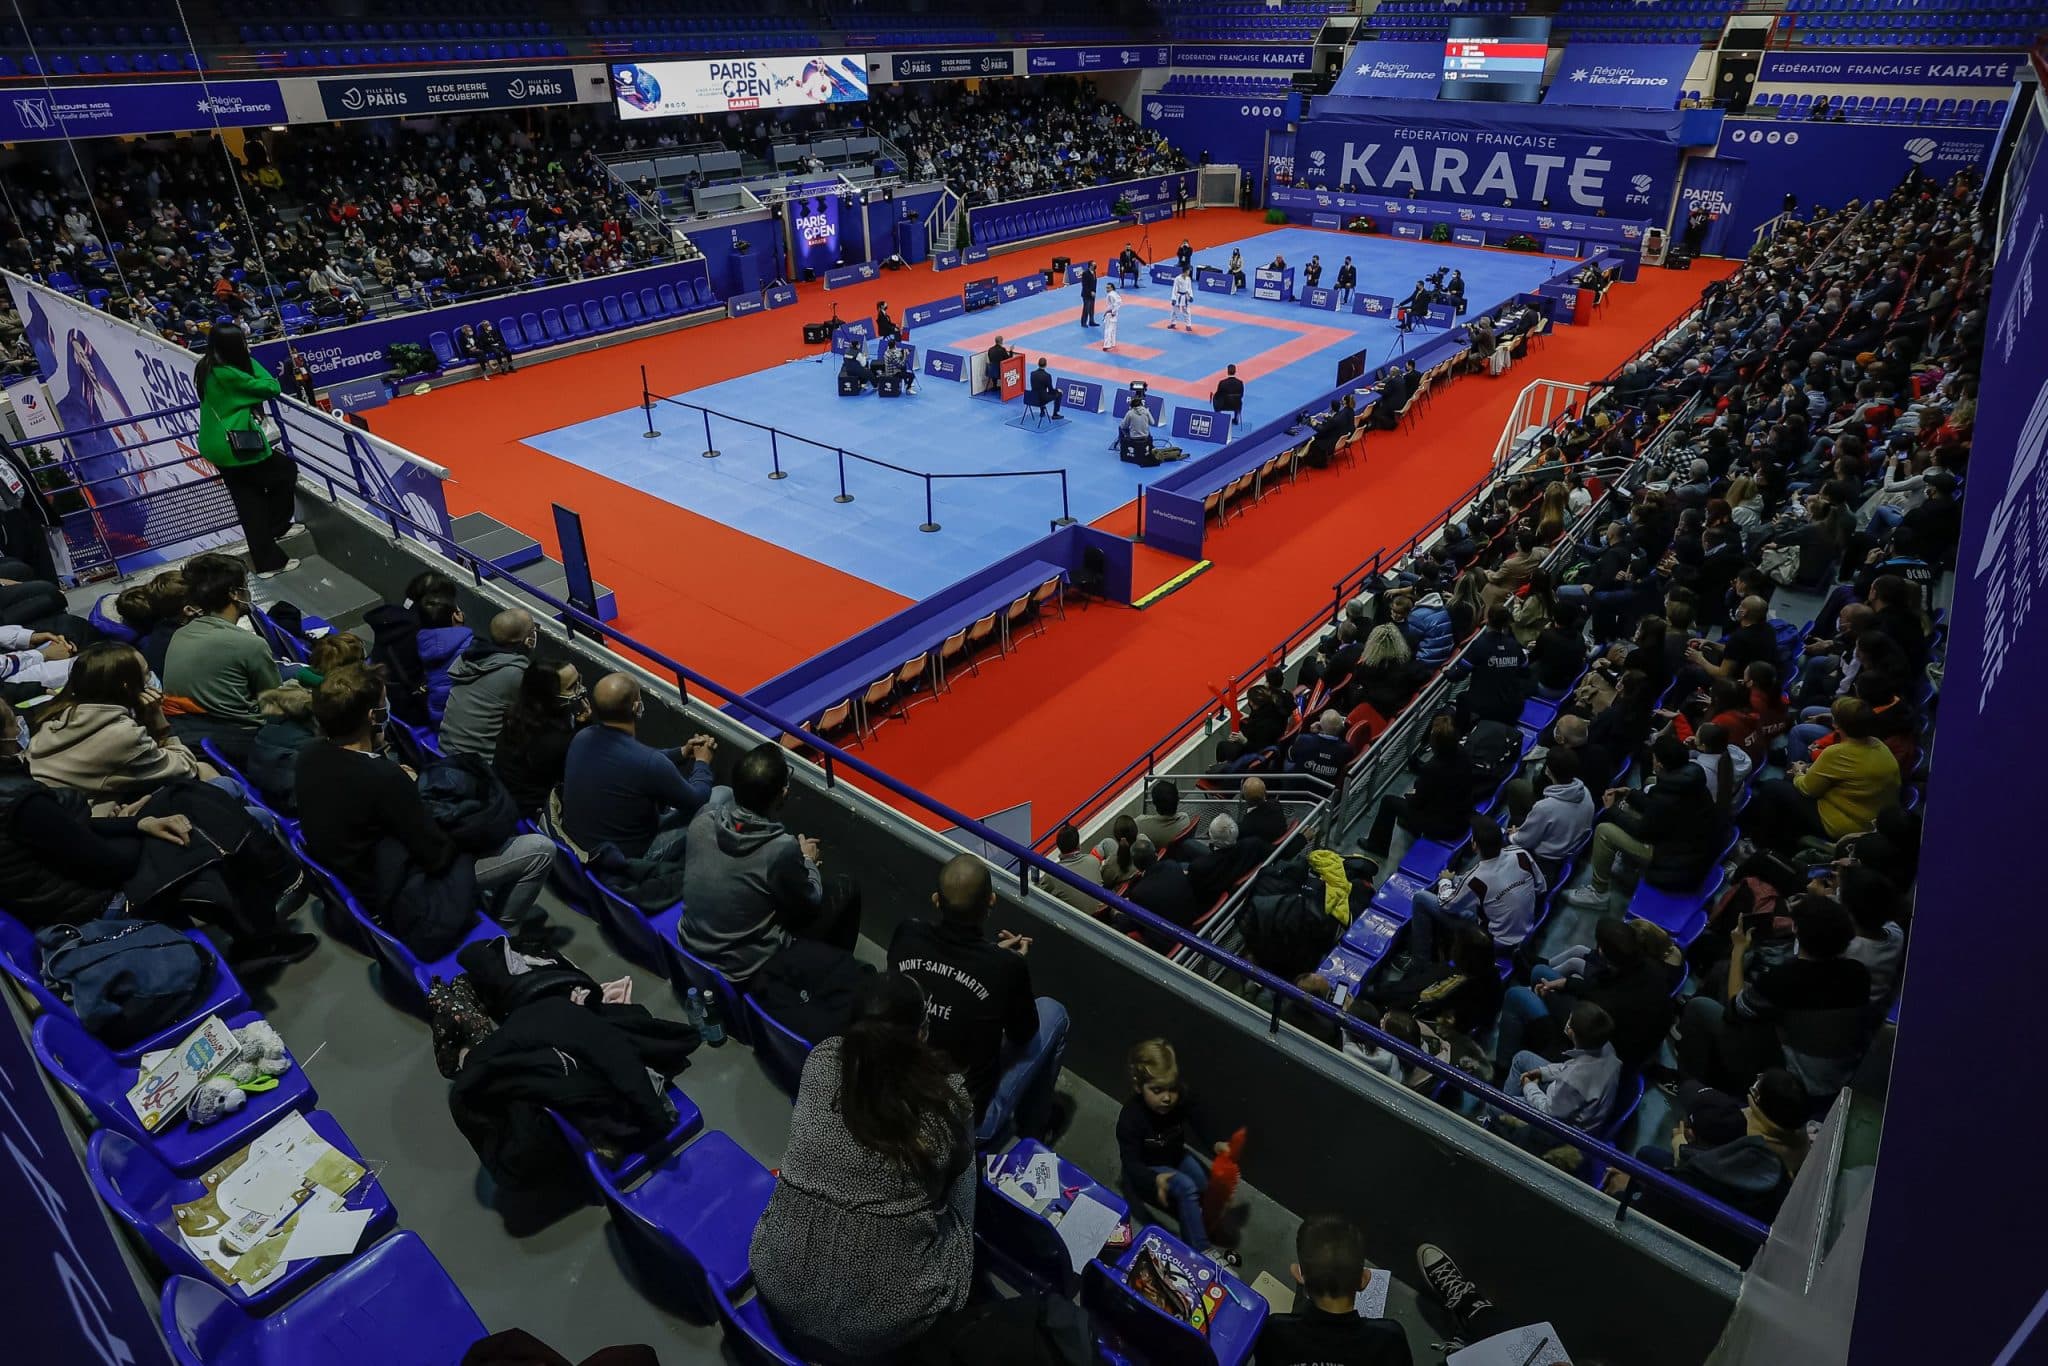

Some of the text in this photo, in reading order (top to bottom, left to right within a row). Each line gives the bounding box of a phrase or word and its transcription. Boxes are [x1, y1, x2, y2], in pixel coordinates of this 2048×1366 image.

[1262, 53, 1305, 64] KARATÉ
[710, 61, 758, 82] PARIS
[912, 64, 932, 73] PARIS
[1375, 62, 1410, 73] Région
[1592, 66, 1634, 78] Région
[1772, 62, 2010, 78] FÉDÉRATION FRANÇAISE KARATÉ
[426, 82, 488, 94] STADE PIERRE
[528, 84, 562, 96] PARIS
[722, 79, 772, 98] OPEN
[366, 92, 408, 106] PARIS
[428, 92, 490, 102] DE COUBERTIN
[1394, 128, 1556, 150] FÉDÉRATION FRANÇAISE
[1938, 152, 1981, 162] KARATÉ
[1308, 168, 1326, 176] FFK
[1340, 142, 1612, 208] KARATÉ
[1626, 193, 1650, 205] FFK
[1682, 188, 1724, 202] PARIS
[1688, 200, 1732, 215] OPEN
[796, 214, 827, 230] PARIS
[804, 224, 835, 240] OPEN
[1978, 543, 2010, 715] KARATÉ
[898, 958, 990, 1001] MONT-SAINT-MARTIN
